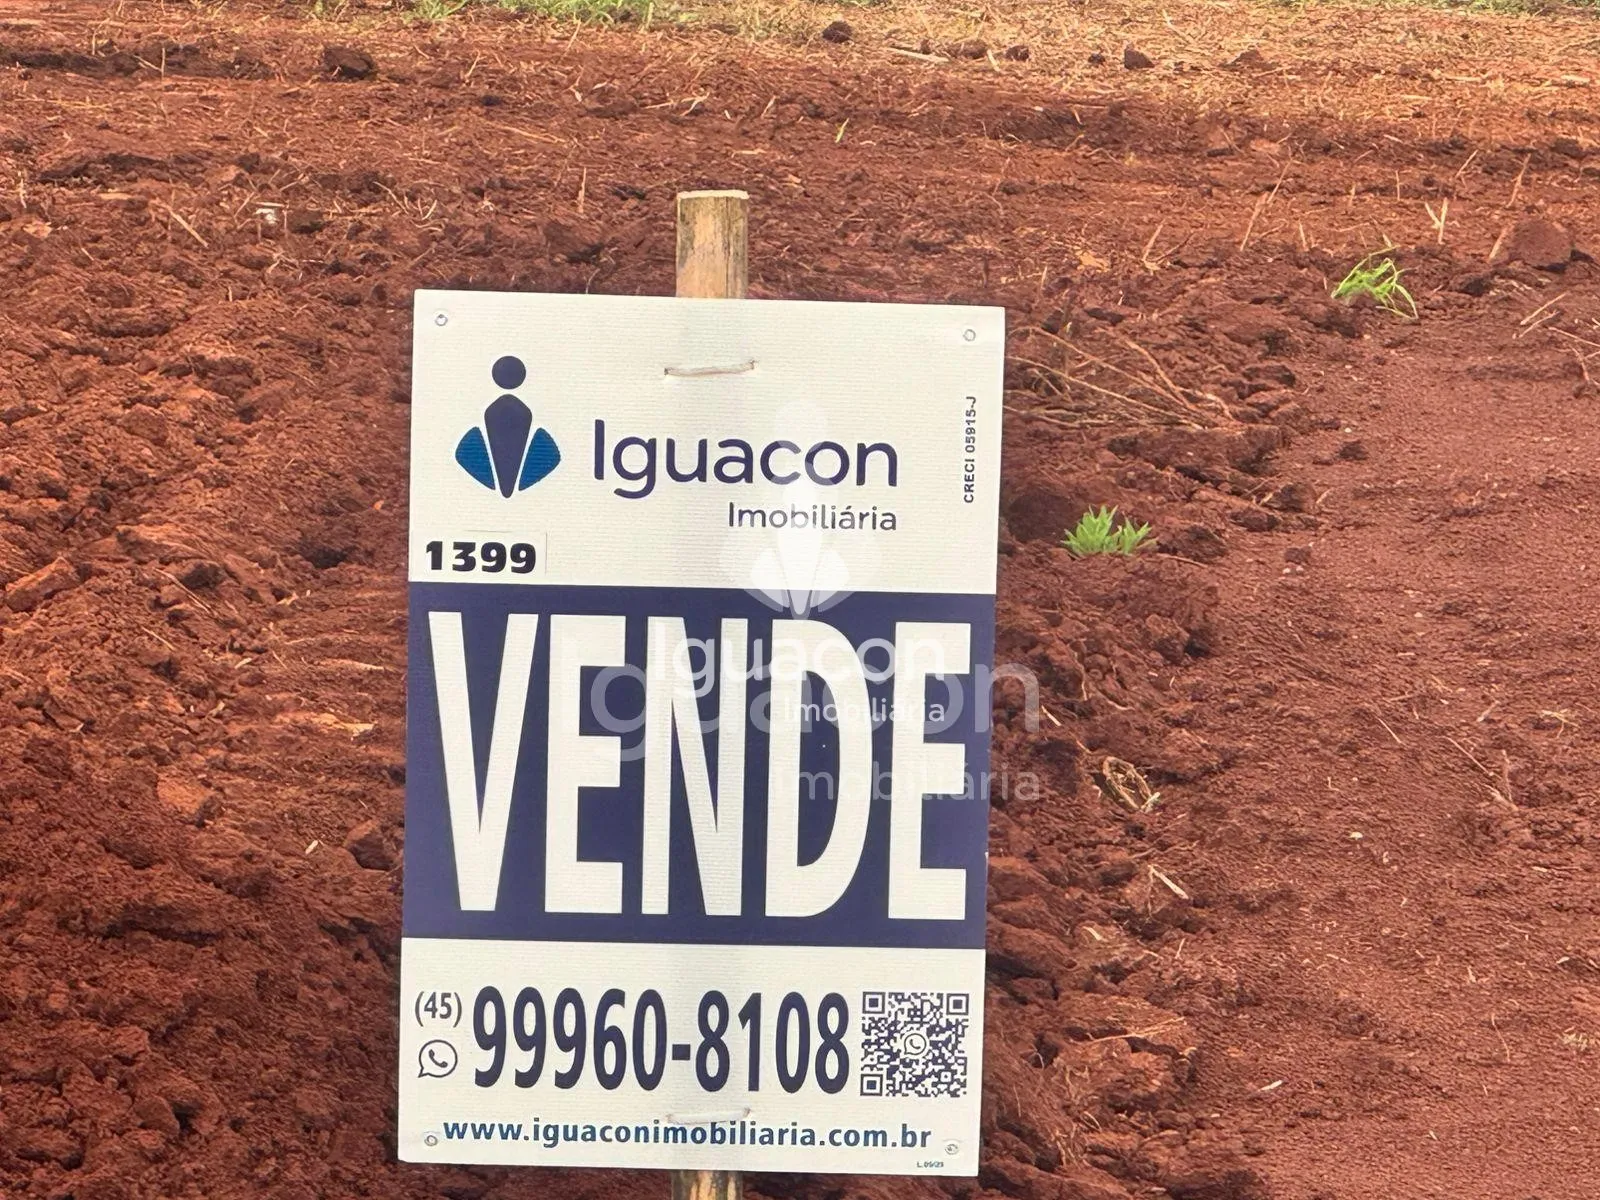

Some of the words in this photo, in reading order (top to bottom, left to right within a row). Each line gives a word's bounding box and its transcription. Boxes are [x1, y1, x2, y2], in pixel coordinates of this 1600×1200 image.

[965, 395, 977, 453] 05915-J
[594, 418, 898, 500] Iguacon
[963, 458, 975, 504] CRECI
[728, 501, 898, 531] Imobiliária
[426, 540, 537, 574] 1399
[428, 610, 972, 921] VENDE
[415, 991, 463, 1028] (45)
[473, 985, 850, 1094] 99960-8108
[443, 1116, 932, 1149] www.iguaconimobiliaria.com.br
